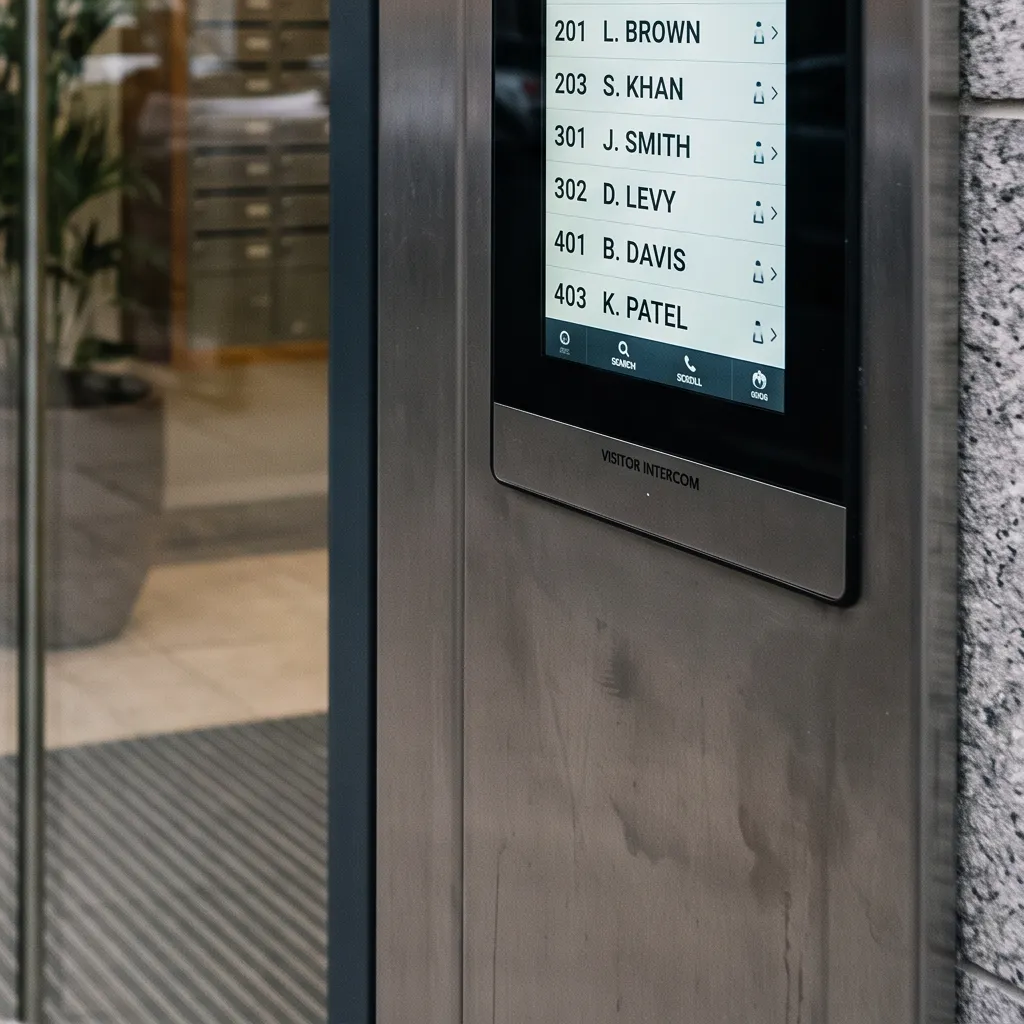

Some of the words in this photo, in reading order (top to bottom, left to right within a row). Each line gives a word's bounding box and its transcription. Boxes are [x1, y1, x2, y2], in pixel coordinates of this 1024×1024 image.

[555, 20, 584, 41] 201
[604, 20, 618, 42] L.
[626, 21, 699, 43] BROWN
[555, 73, 586, 95] 203
[604, 75, 619, 96] S.
[627, 76, 682, 100] KHAN
[555, 125, 584, 148] 301
[603, 129, 618, 151] J.
[626, 131, 689, 158] SMITH
[555, 177, 587, 202] 302
[604, 183, 619, 206] D.
[627, 185, 676, 212] LEVY
[555, 231, 583, 255] 401
[604, 237, 619, 260] B.
[627, 241, 685, 271] DAVIS
[555, 283, 586, 308] 403
[604, 291, 619, 315] K.
[627, 296, 687, 330] PATEL
[602, 449, 640, 472] VISITOR
[643, 461, 700, 491] INTERCOM
